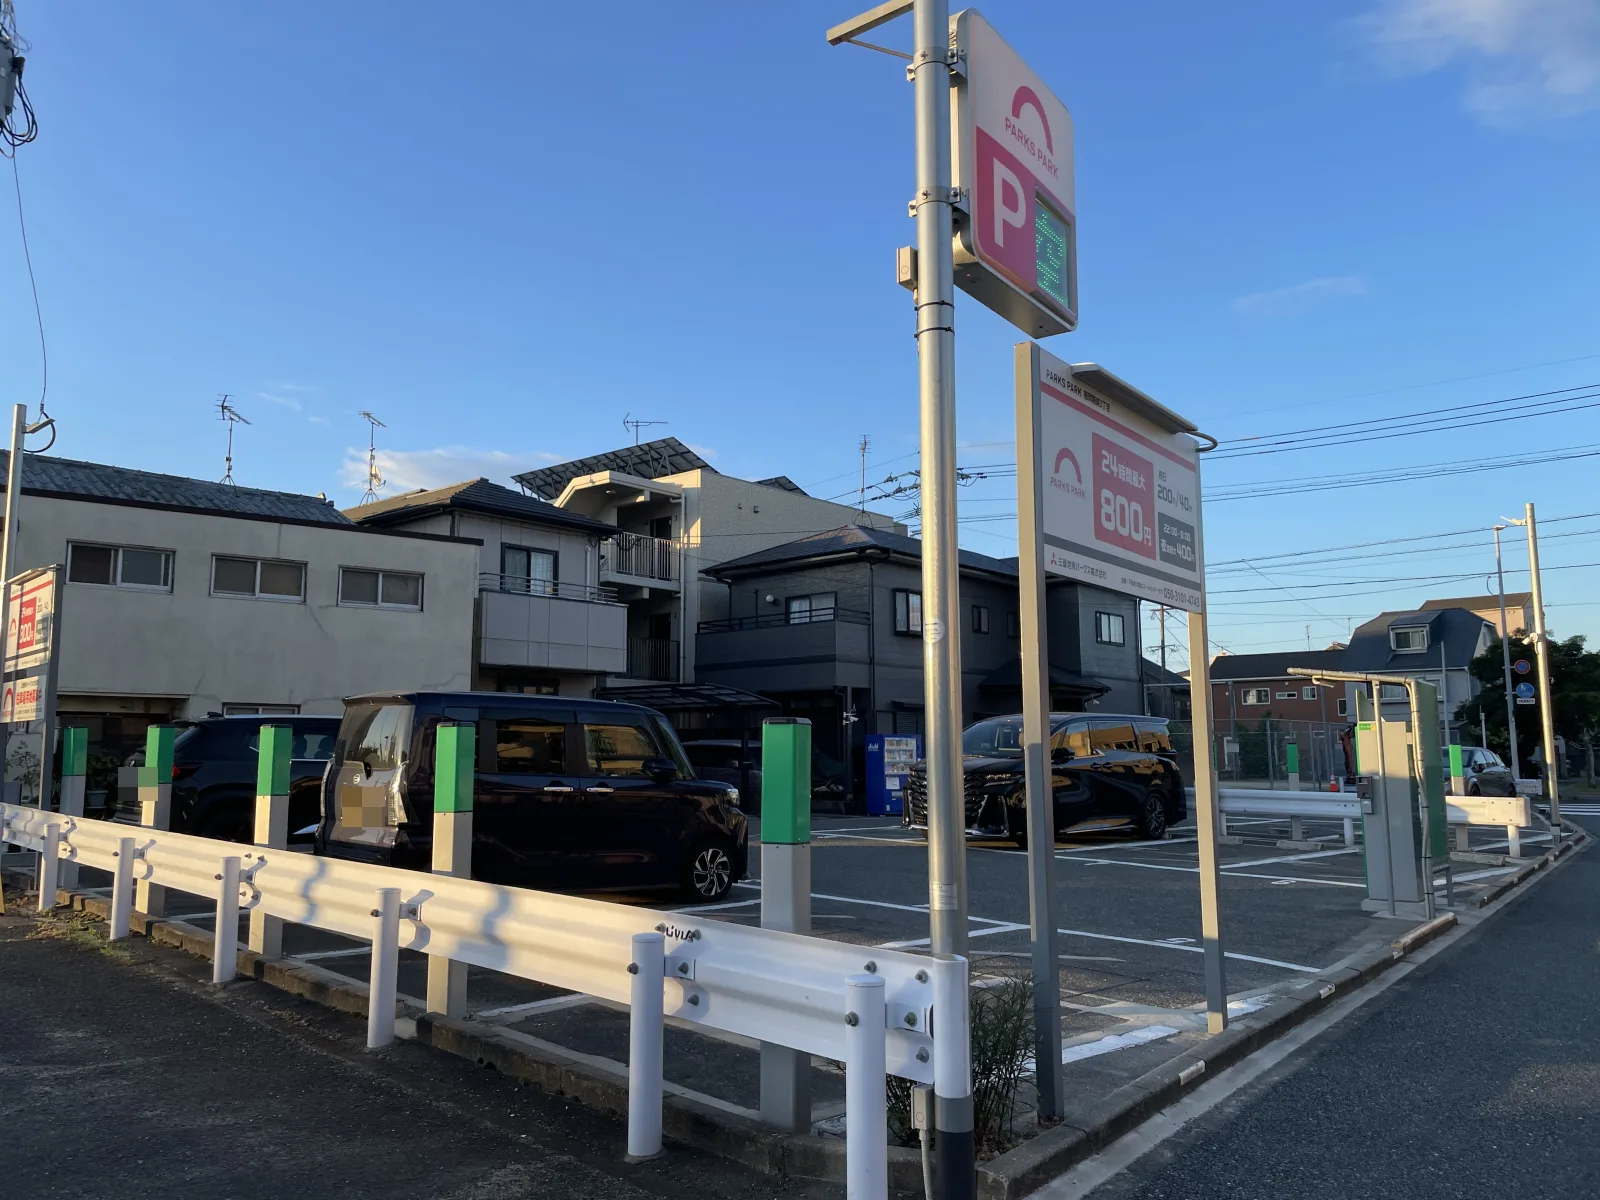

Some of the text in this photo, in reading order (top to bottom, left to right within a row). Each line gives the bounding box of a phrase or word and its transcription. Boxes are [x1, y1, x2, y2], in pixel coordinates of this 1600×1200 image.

[1005, 117, 1059, 182] PARKS PARK
[993, 157, 1027, 248] P
[1046, 369, 1082, 397] PARKS PARK
[1050, 476, 1086, 500] PARKS PARK
[1102, 449, 1146, 492] 24時間最大
[1101, 488, 1152, 547] 800円
